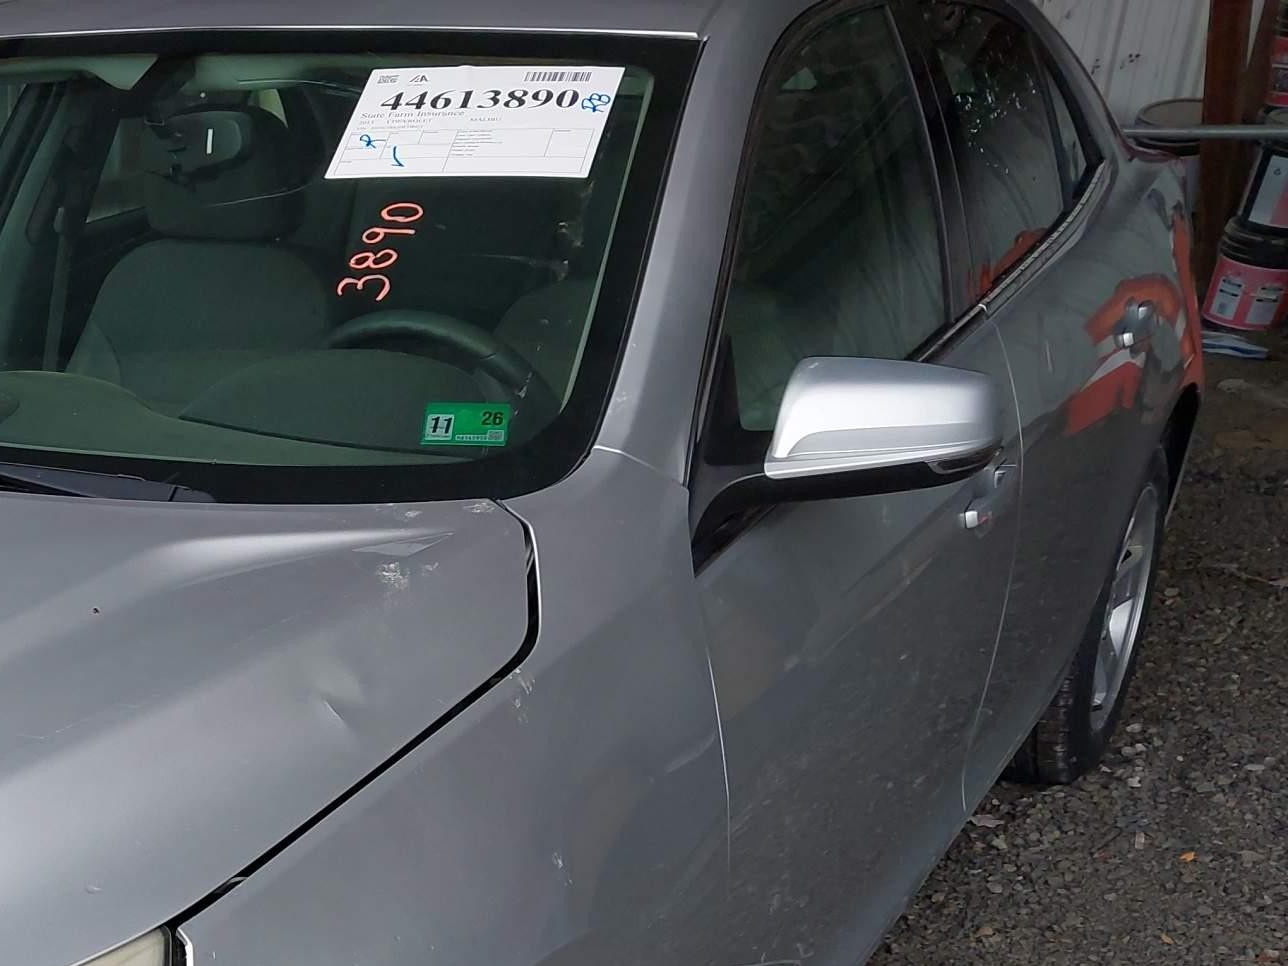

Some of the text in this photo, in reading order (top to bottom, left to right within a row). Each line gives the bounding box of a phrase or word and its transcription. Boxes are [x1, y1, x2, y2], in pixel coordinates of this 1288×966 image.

[381, 88, 579, 111] 44613890
[337, 202, 424, 301] 3890
[431, 415, 453, 434] 11
[481, 410, 504, 426] 26
